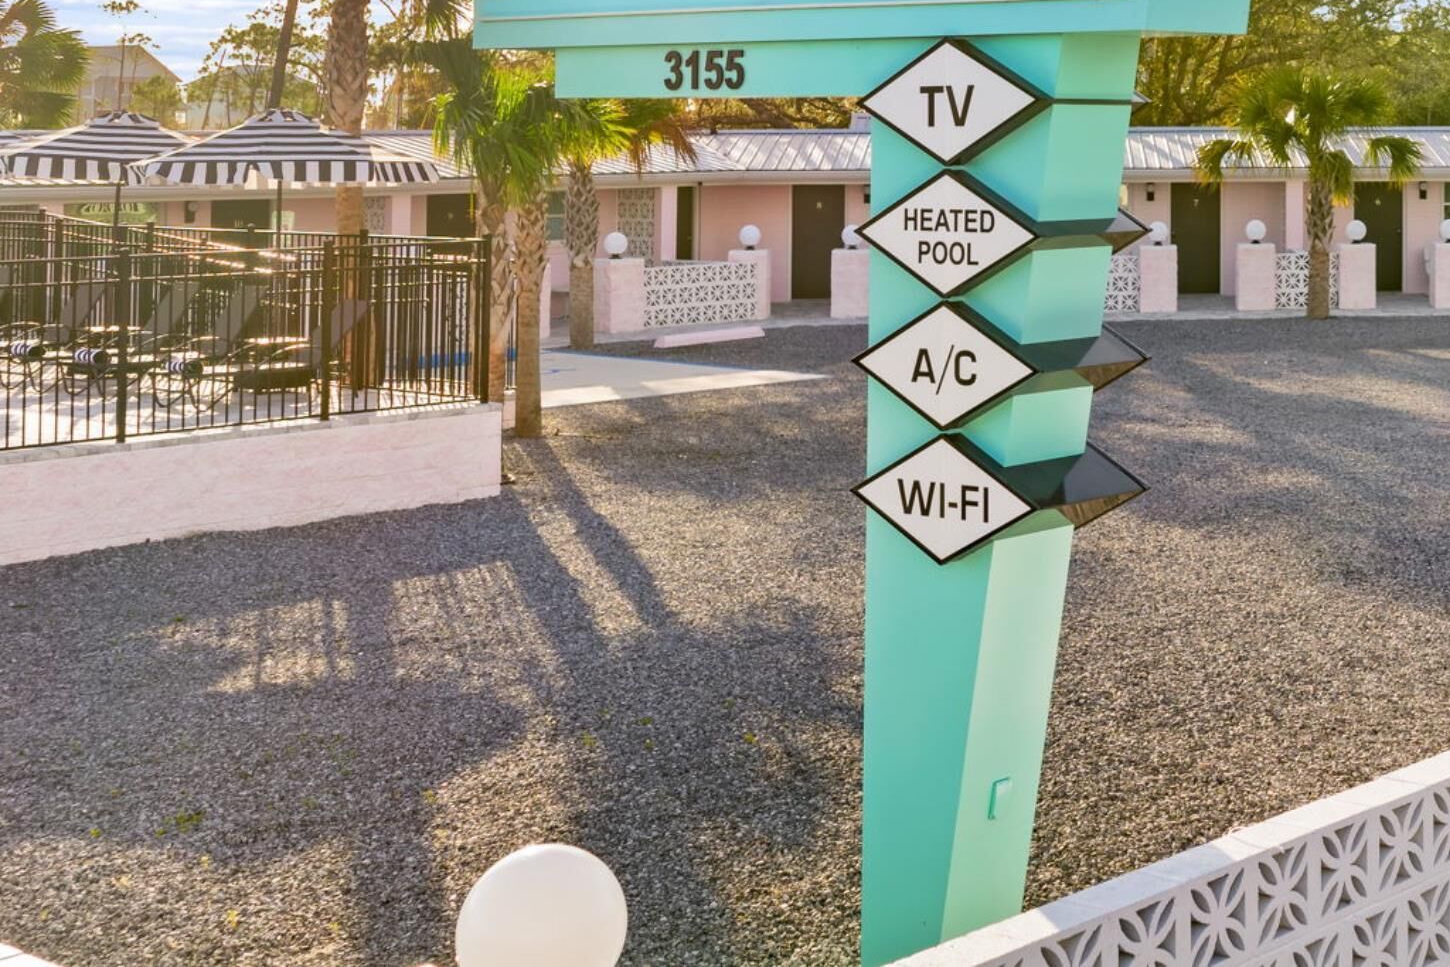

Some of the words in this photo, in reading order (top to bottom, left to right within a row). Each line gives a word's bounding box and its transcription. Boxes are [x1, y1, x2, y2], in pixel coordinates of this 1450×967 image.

[664, 49, 746, 91] 3155
[919, 84, 975, 128] TV
[903, 208, 996, 235] HEATED
[917, 240, 980, 266] POOL
[911, 344, 978, 395] A/C
[898, 477, 990, 524] WI-FI
